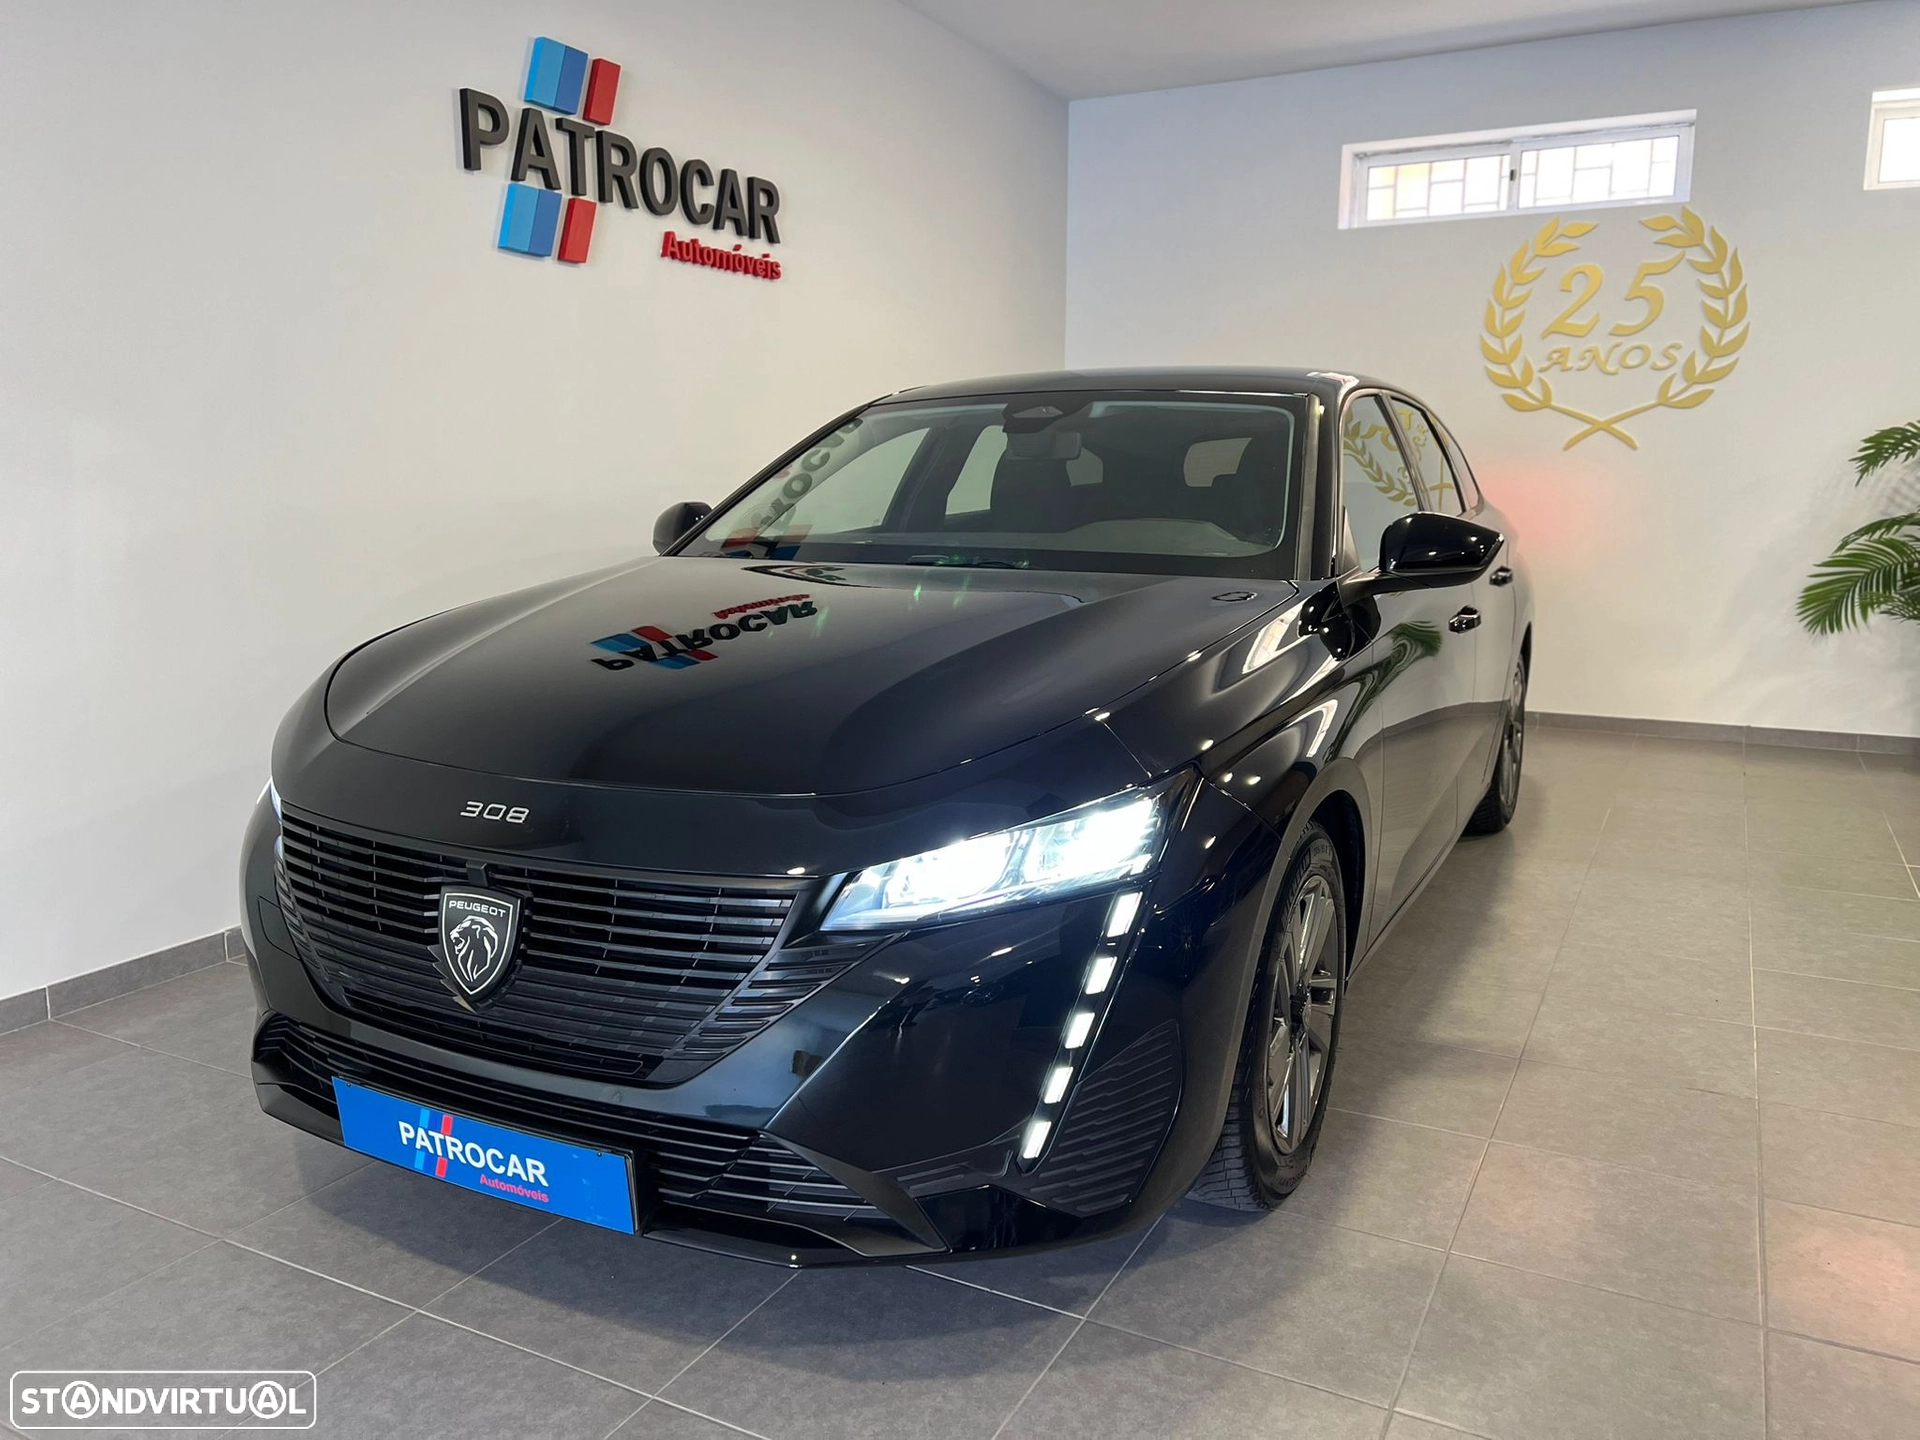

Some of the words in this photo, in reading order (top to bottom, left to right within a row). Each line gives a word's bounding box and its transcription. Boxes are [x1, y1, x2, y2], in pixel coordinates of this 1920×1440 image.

[459, 88, 780, 244] PATROCAR
[660, 231, 782, 280] Automóveis
[1541, 251, 1686, 340] 25
[1538, 342, 1682, 376] ANOS
[459, 801, 530, 824] 308
[448, 899, 507, 918] PEUGEOT
[397, 1121, 550, 1187] PATROCAR
[479, 1174, 550, 1203] Automóveis
